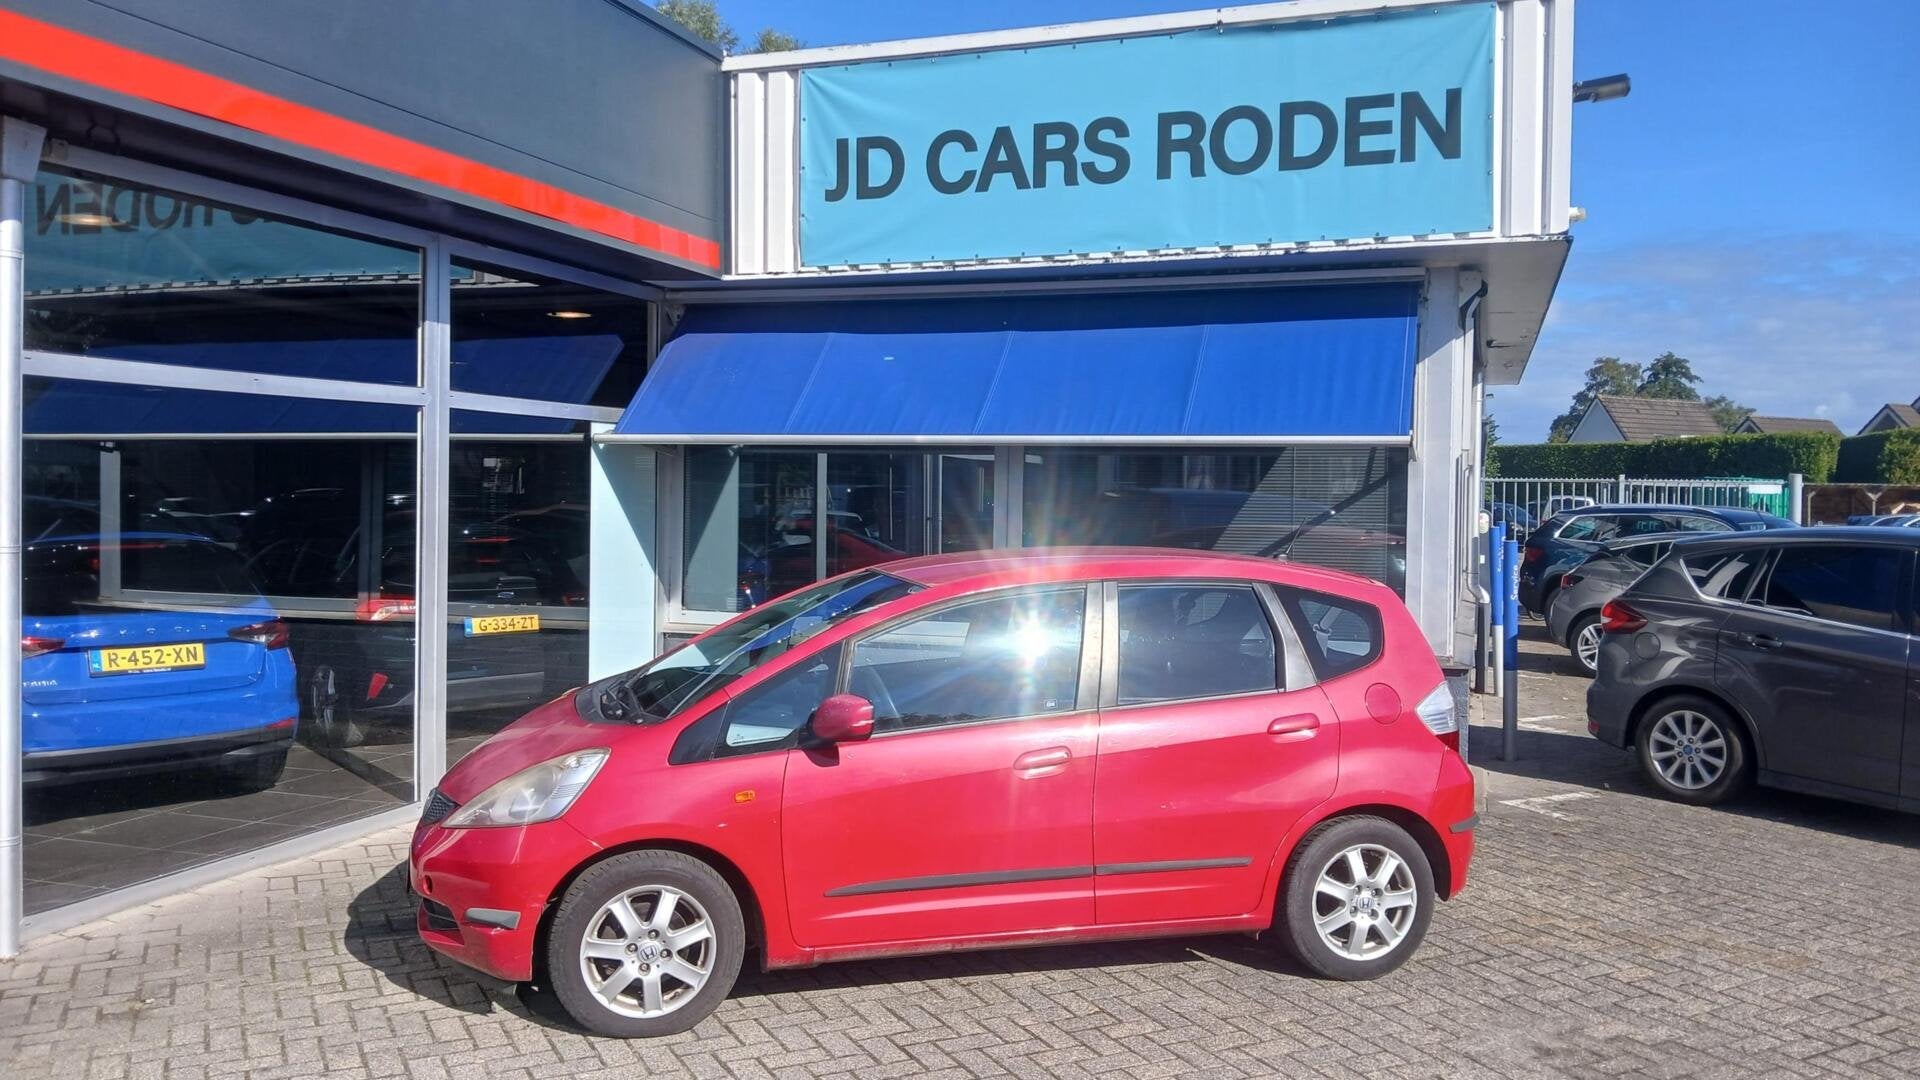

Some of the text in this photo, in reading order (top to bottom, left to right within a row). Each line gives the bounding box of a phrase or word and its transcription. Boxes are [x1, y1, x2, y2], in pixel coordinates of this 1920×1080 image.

[825, 88, 1462, 203] JD CARS RODEN
[1510, 565, 1519, 600] Service
[479, 616, 535, 632] G-334-ZT
[107, 646, 198, 668] R-452-XN
